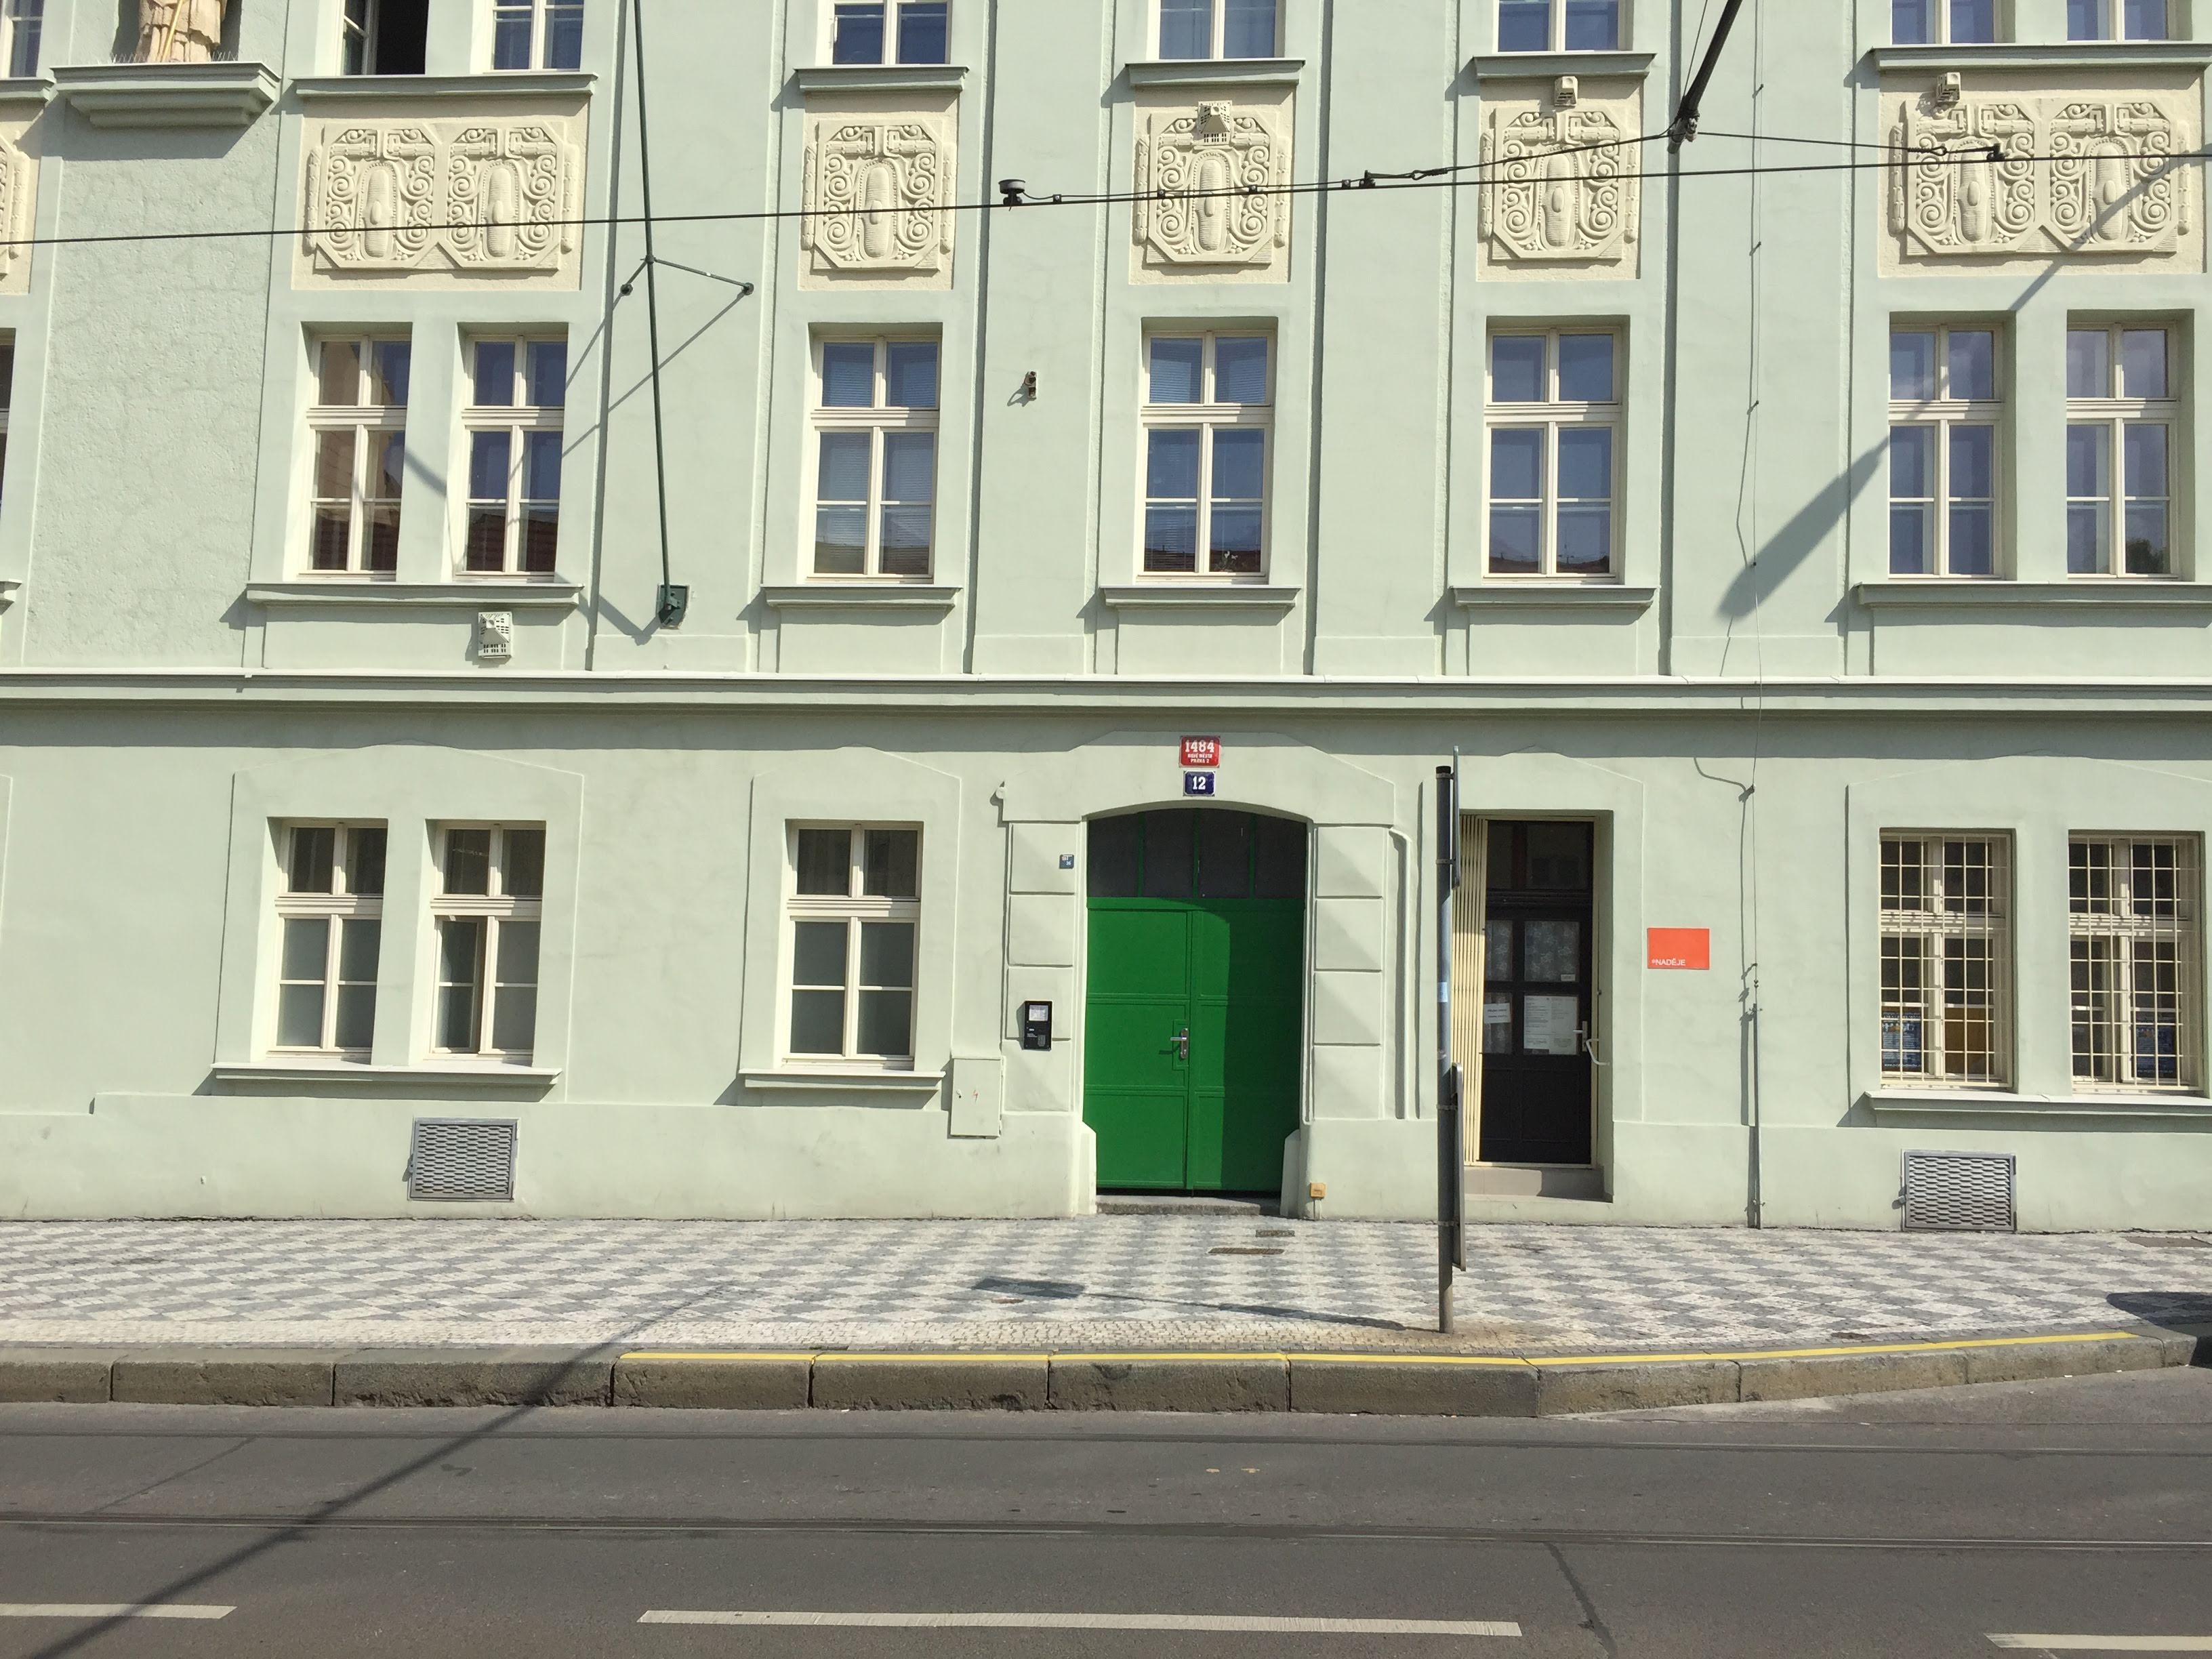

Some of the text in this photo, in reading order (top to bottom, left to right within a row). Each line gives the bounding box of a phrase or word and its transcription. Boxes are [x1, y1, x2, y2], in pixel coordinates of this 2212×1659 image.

[1185, 739, 1214, 752] 1484
[1193, 776, 1206, 790] 12
[1655, 958, 1686, 966] NADĚJE
